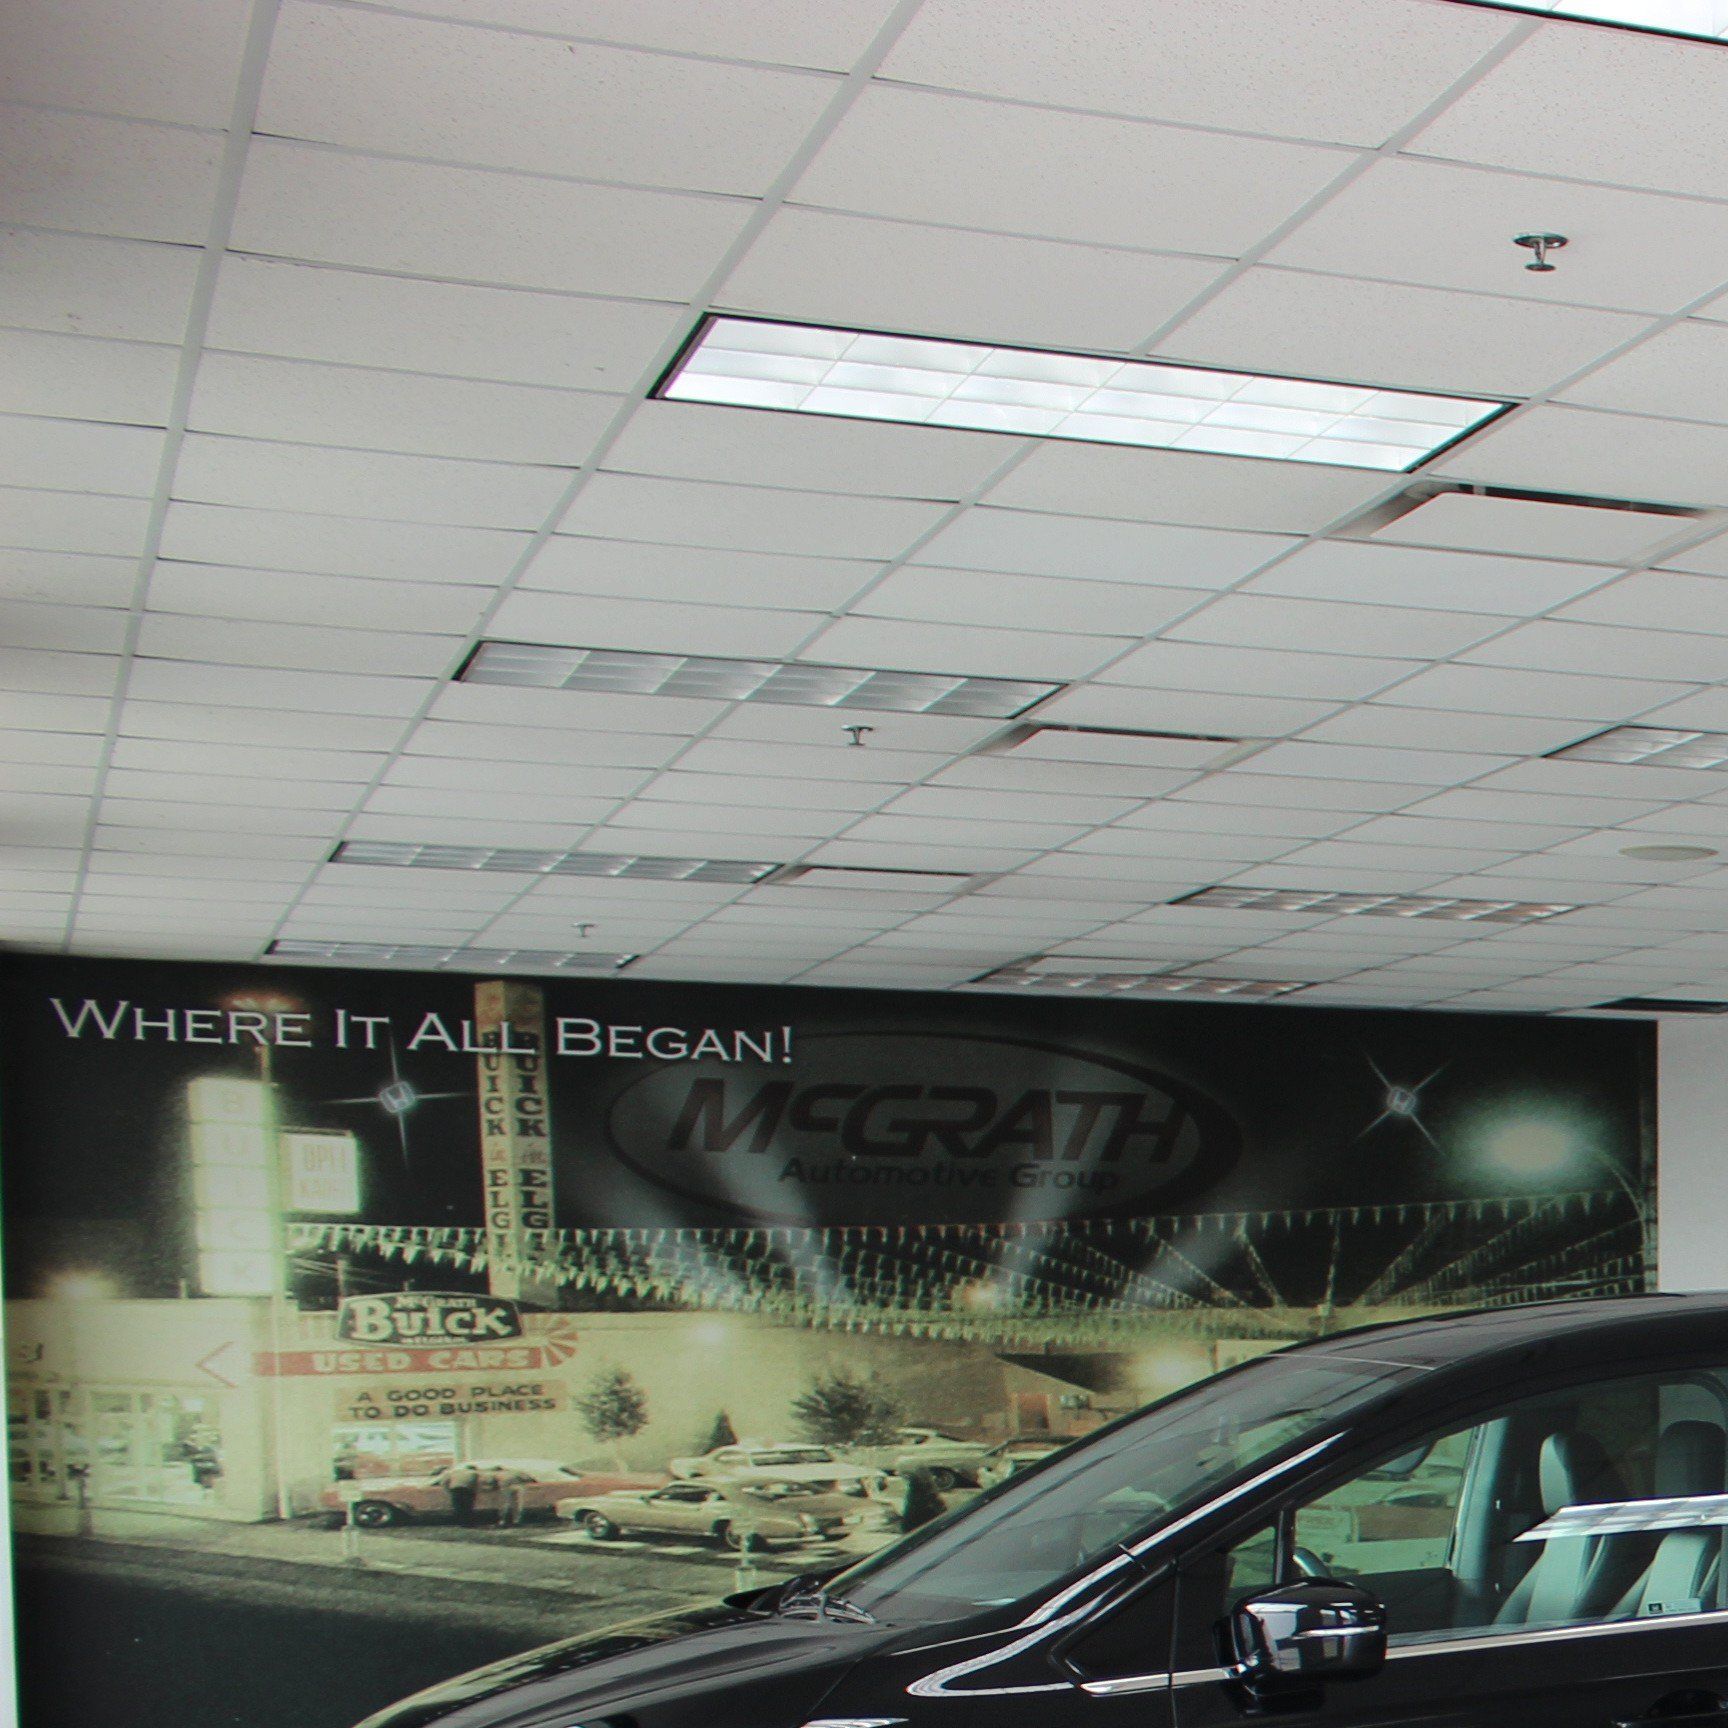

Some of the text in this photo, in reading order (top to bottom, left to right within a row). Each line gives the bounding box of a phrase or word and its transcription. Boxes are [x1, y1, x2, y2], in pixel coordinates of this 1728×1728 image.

[778, 1157, 1118, 1192] Automotive Group
[312, 1349, 530, 1372] USED CARS
[358, 1384, 544, 1402] A GOOD PLACE
[350, 1398, 556, 1419] TO DO BUSINESS
